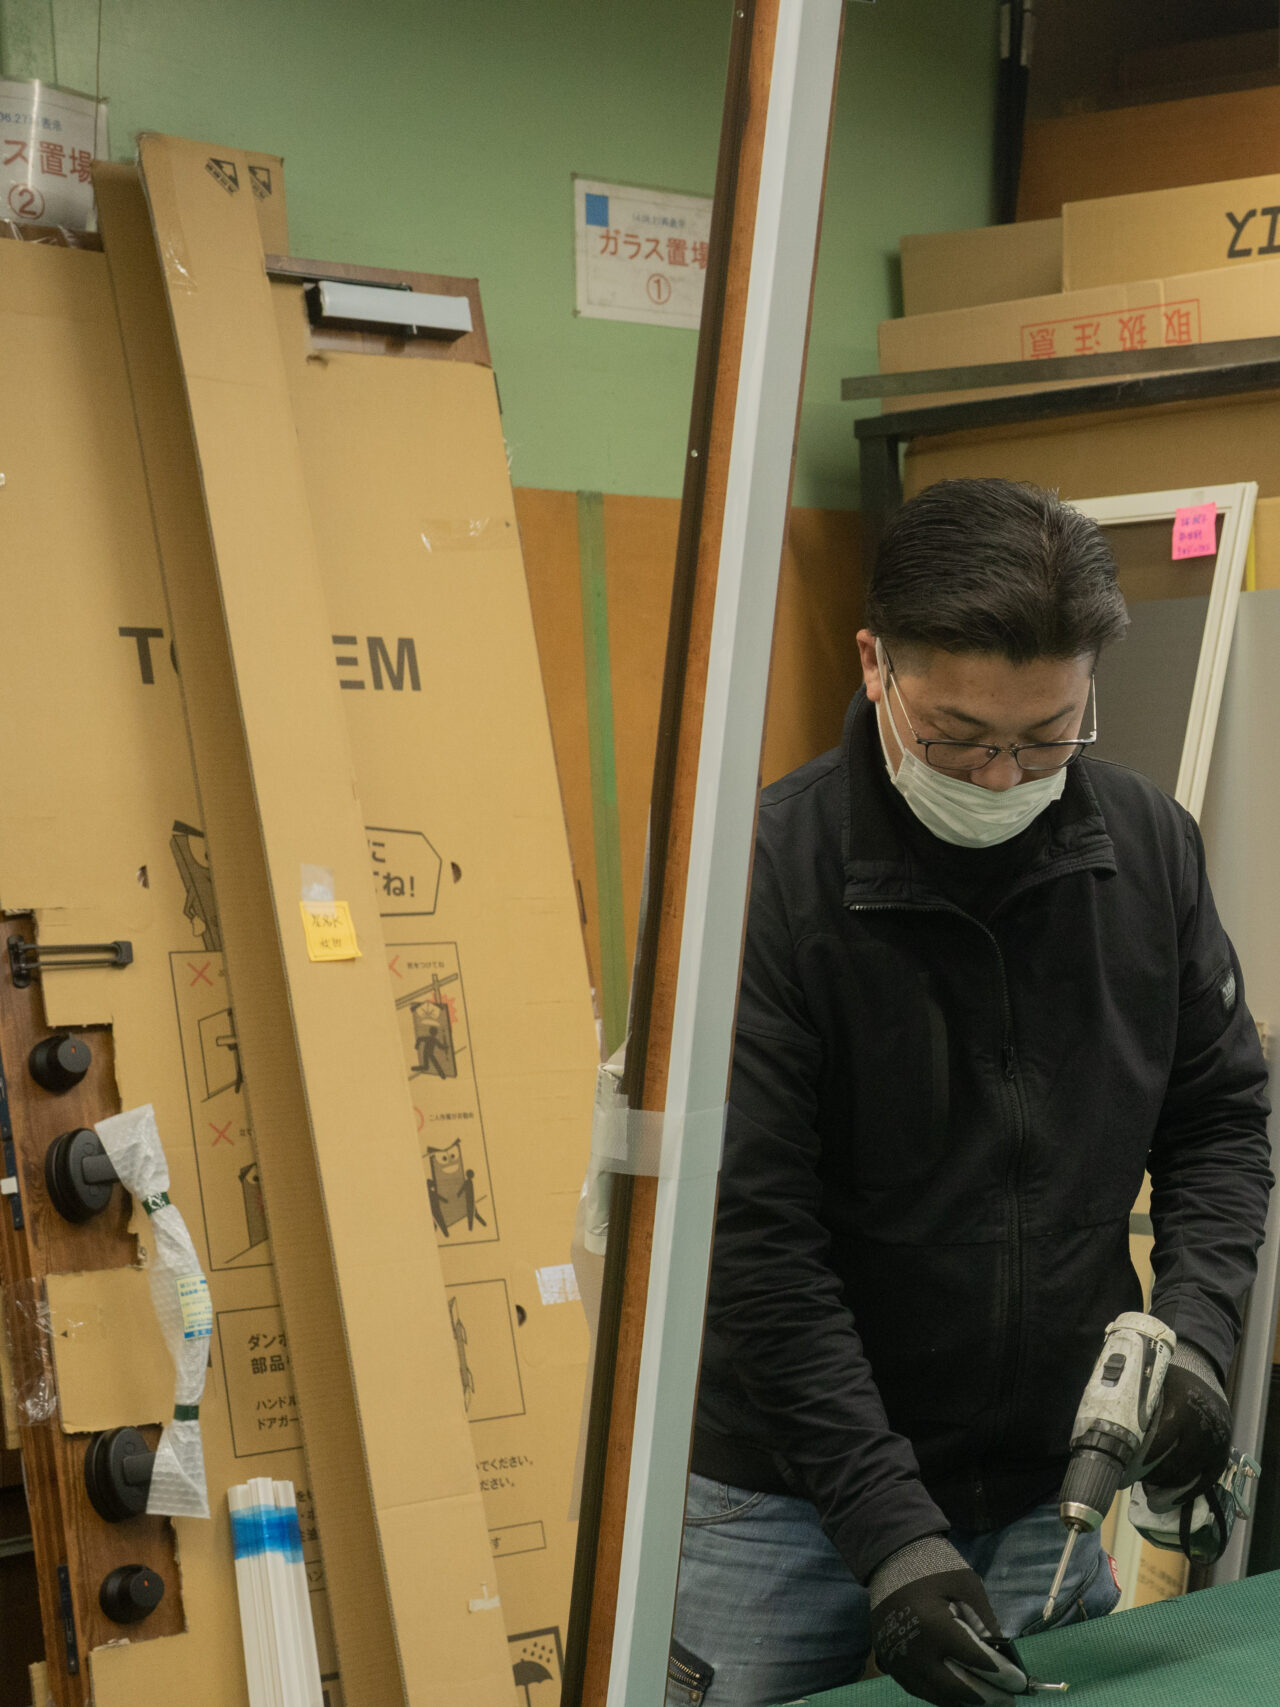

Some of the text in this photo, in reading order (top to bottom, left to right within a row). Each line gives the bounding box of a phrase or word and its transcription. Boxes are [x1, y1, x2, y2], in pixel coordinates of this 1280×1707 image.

[599, 228, 709, 270] ガラス置場
[1028, 308, 1193, 360] 取扱注意
[373, 871, 415, 898] ね!
[251, 1355, 289, 1374] 部品
